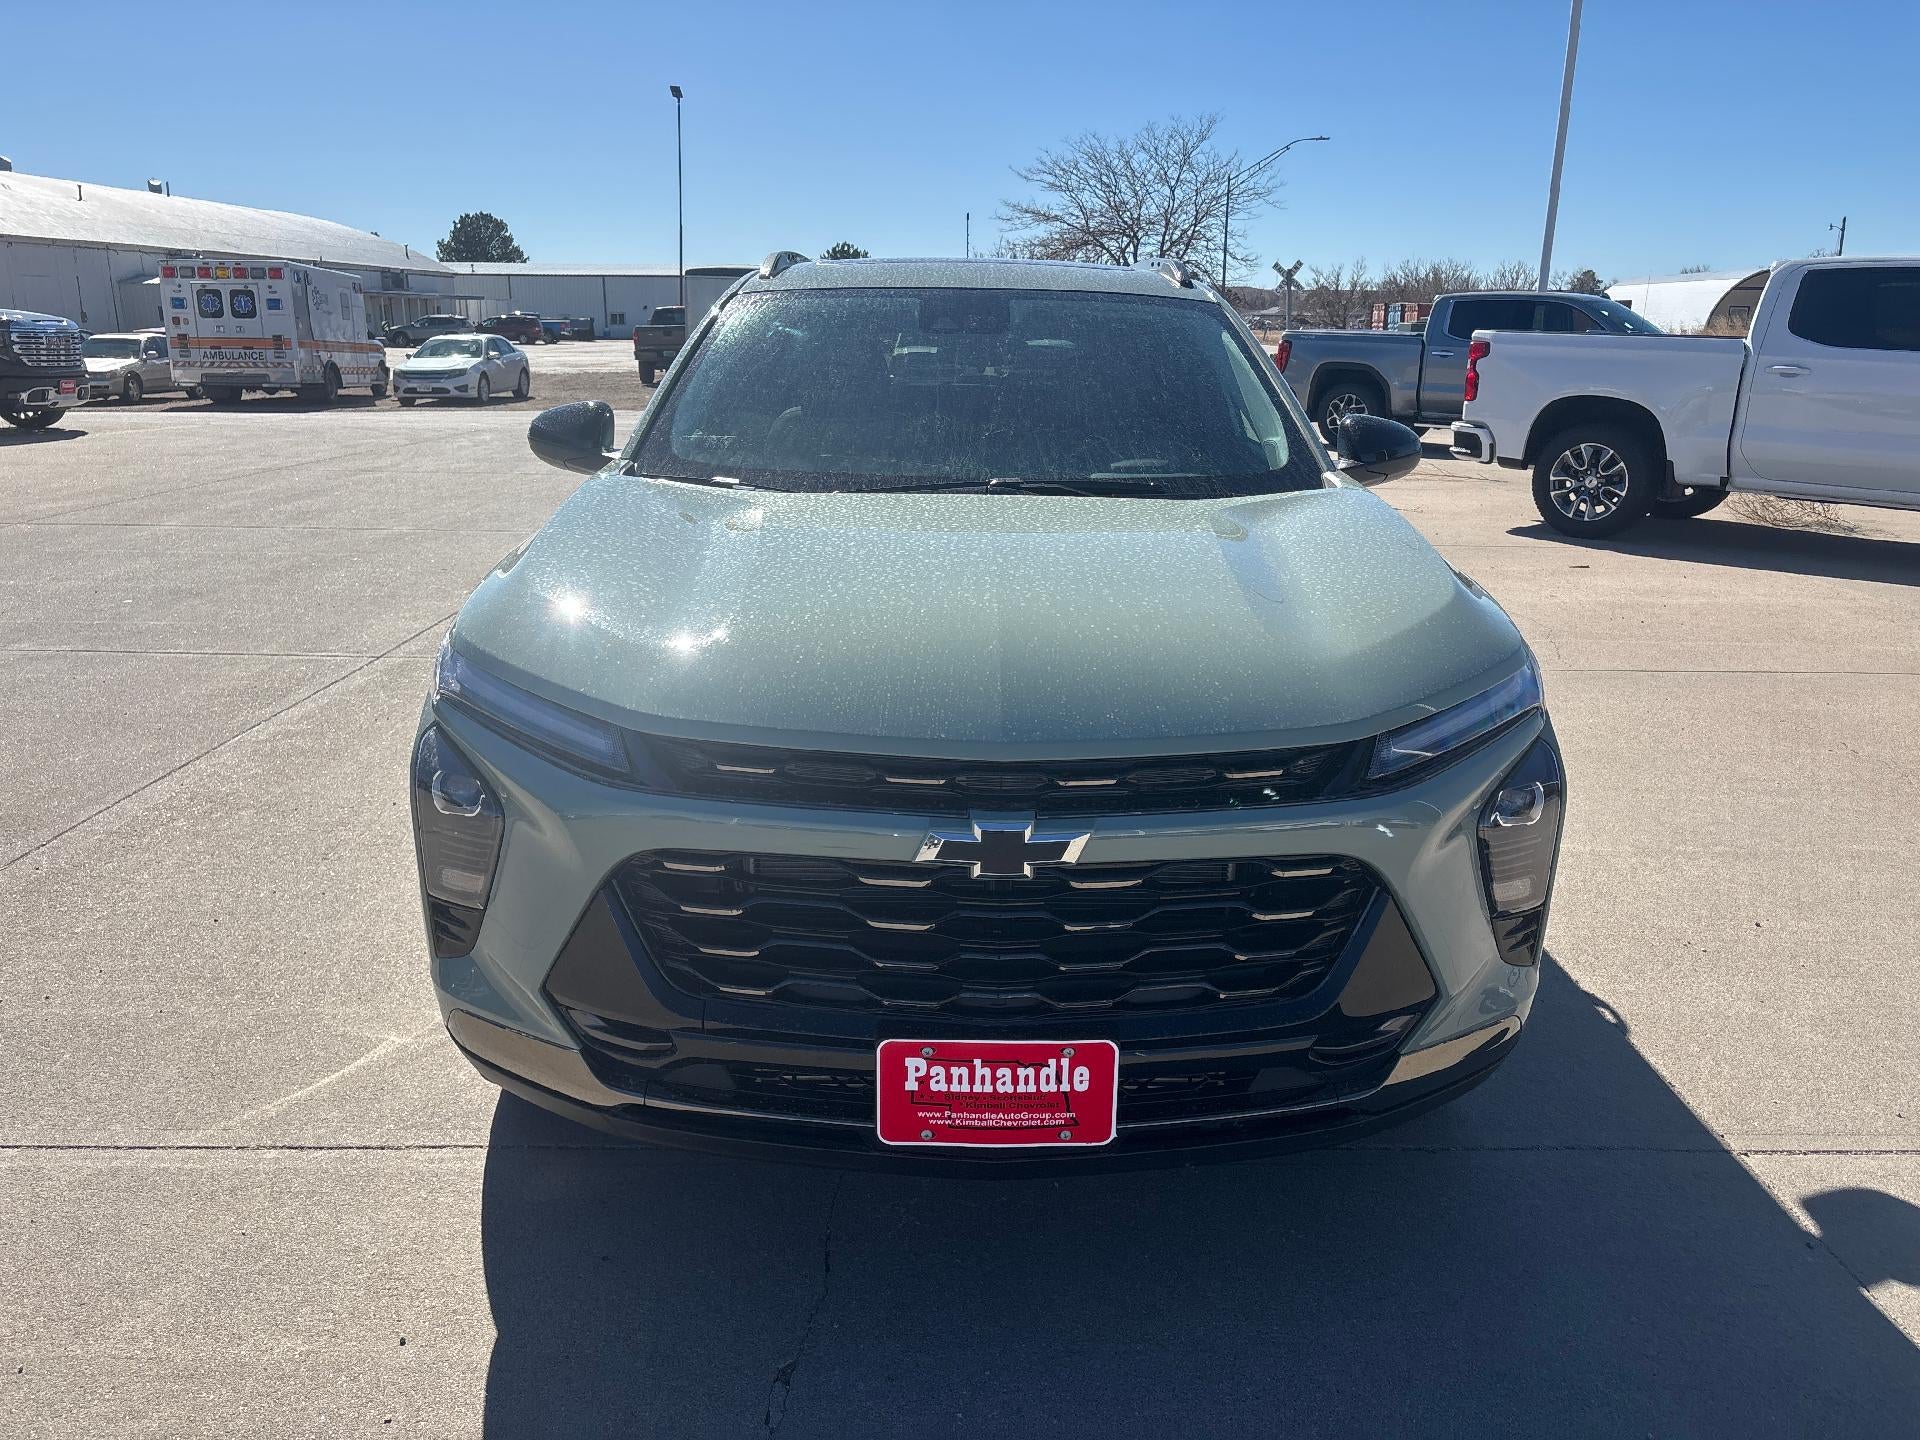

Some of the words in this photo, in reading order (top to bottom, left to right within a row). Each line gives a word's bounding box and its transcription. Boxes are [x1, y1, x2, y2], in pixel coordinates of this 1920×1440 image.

[202, 350, 265, 361] AMBULANCE
[904, 1057, 1090, 1094] Panhandle
[944, 1093, 980, 1102] Sidney
[965, 1101, 1006, 1109] Kimball
[1009, 1101, 1060, 1109] Chevrolet
[917, 1110, 1076, 1120] www.PanhandleAutoGroup.com
[929, 1118, 1065, 1127] www.KimballChevrolet.com
